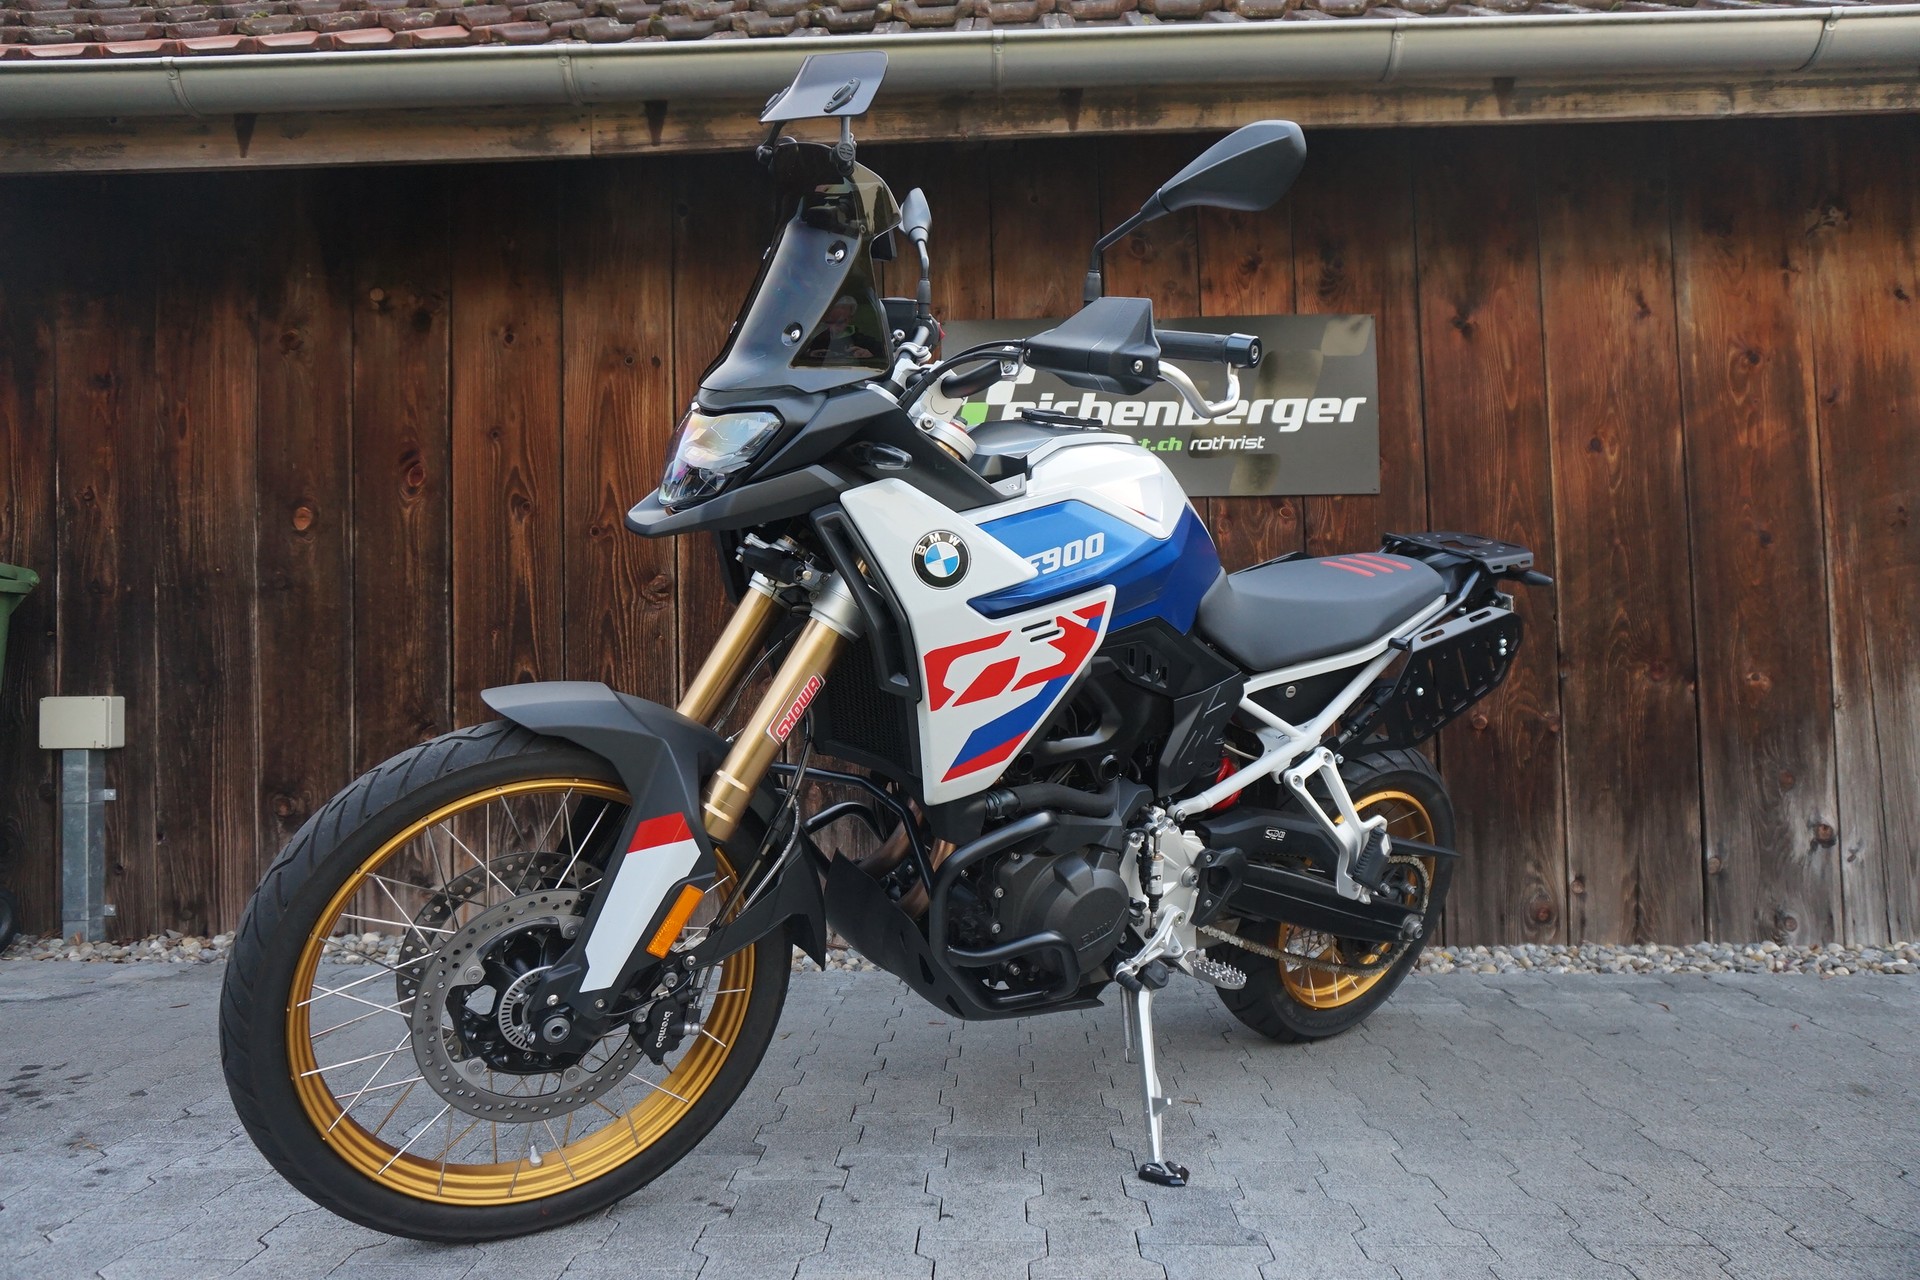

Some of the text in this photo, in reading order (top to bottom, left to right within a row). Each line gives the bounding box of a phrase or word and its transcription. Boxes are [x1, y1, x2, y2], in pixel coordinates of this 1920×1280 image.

[1189, 435, 1266, 450] rothrist
[915, 532, 960, 556] BMW
[776, 675, 821, 742] SHOWA
[655, 1011, 673, 1048] brembo
